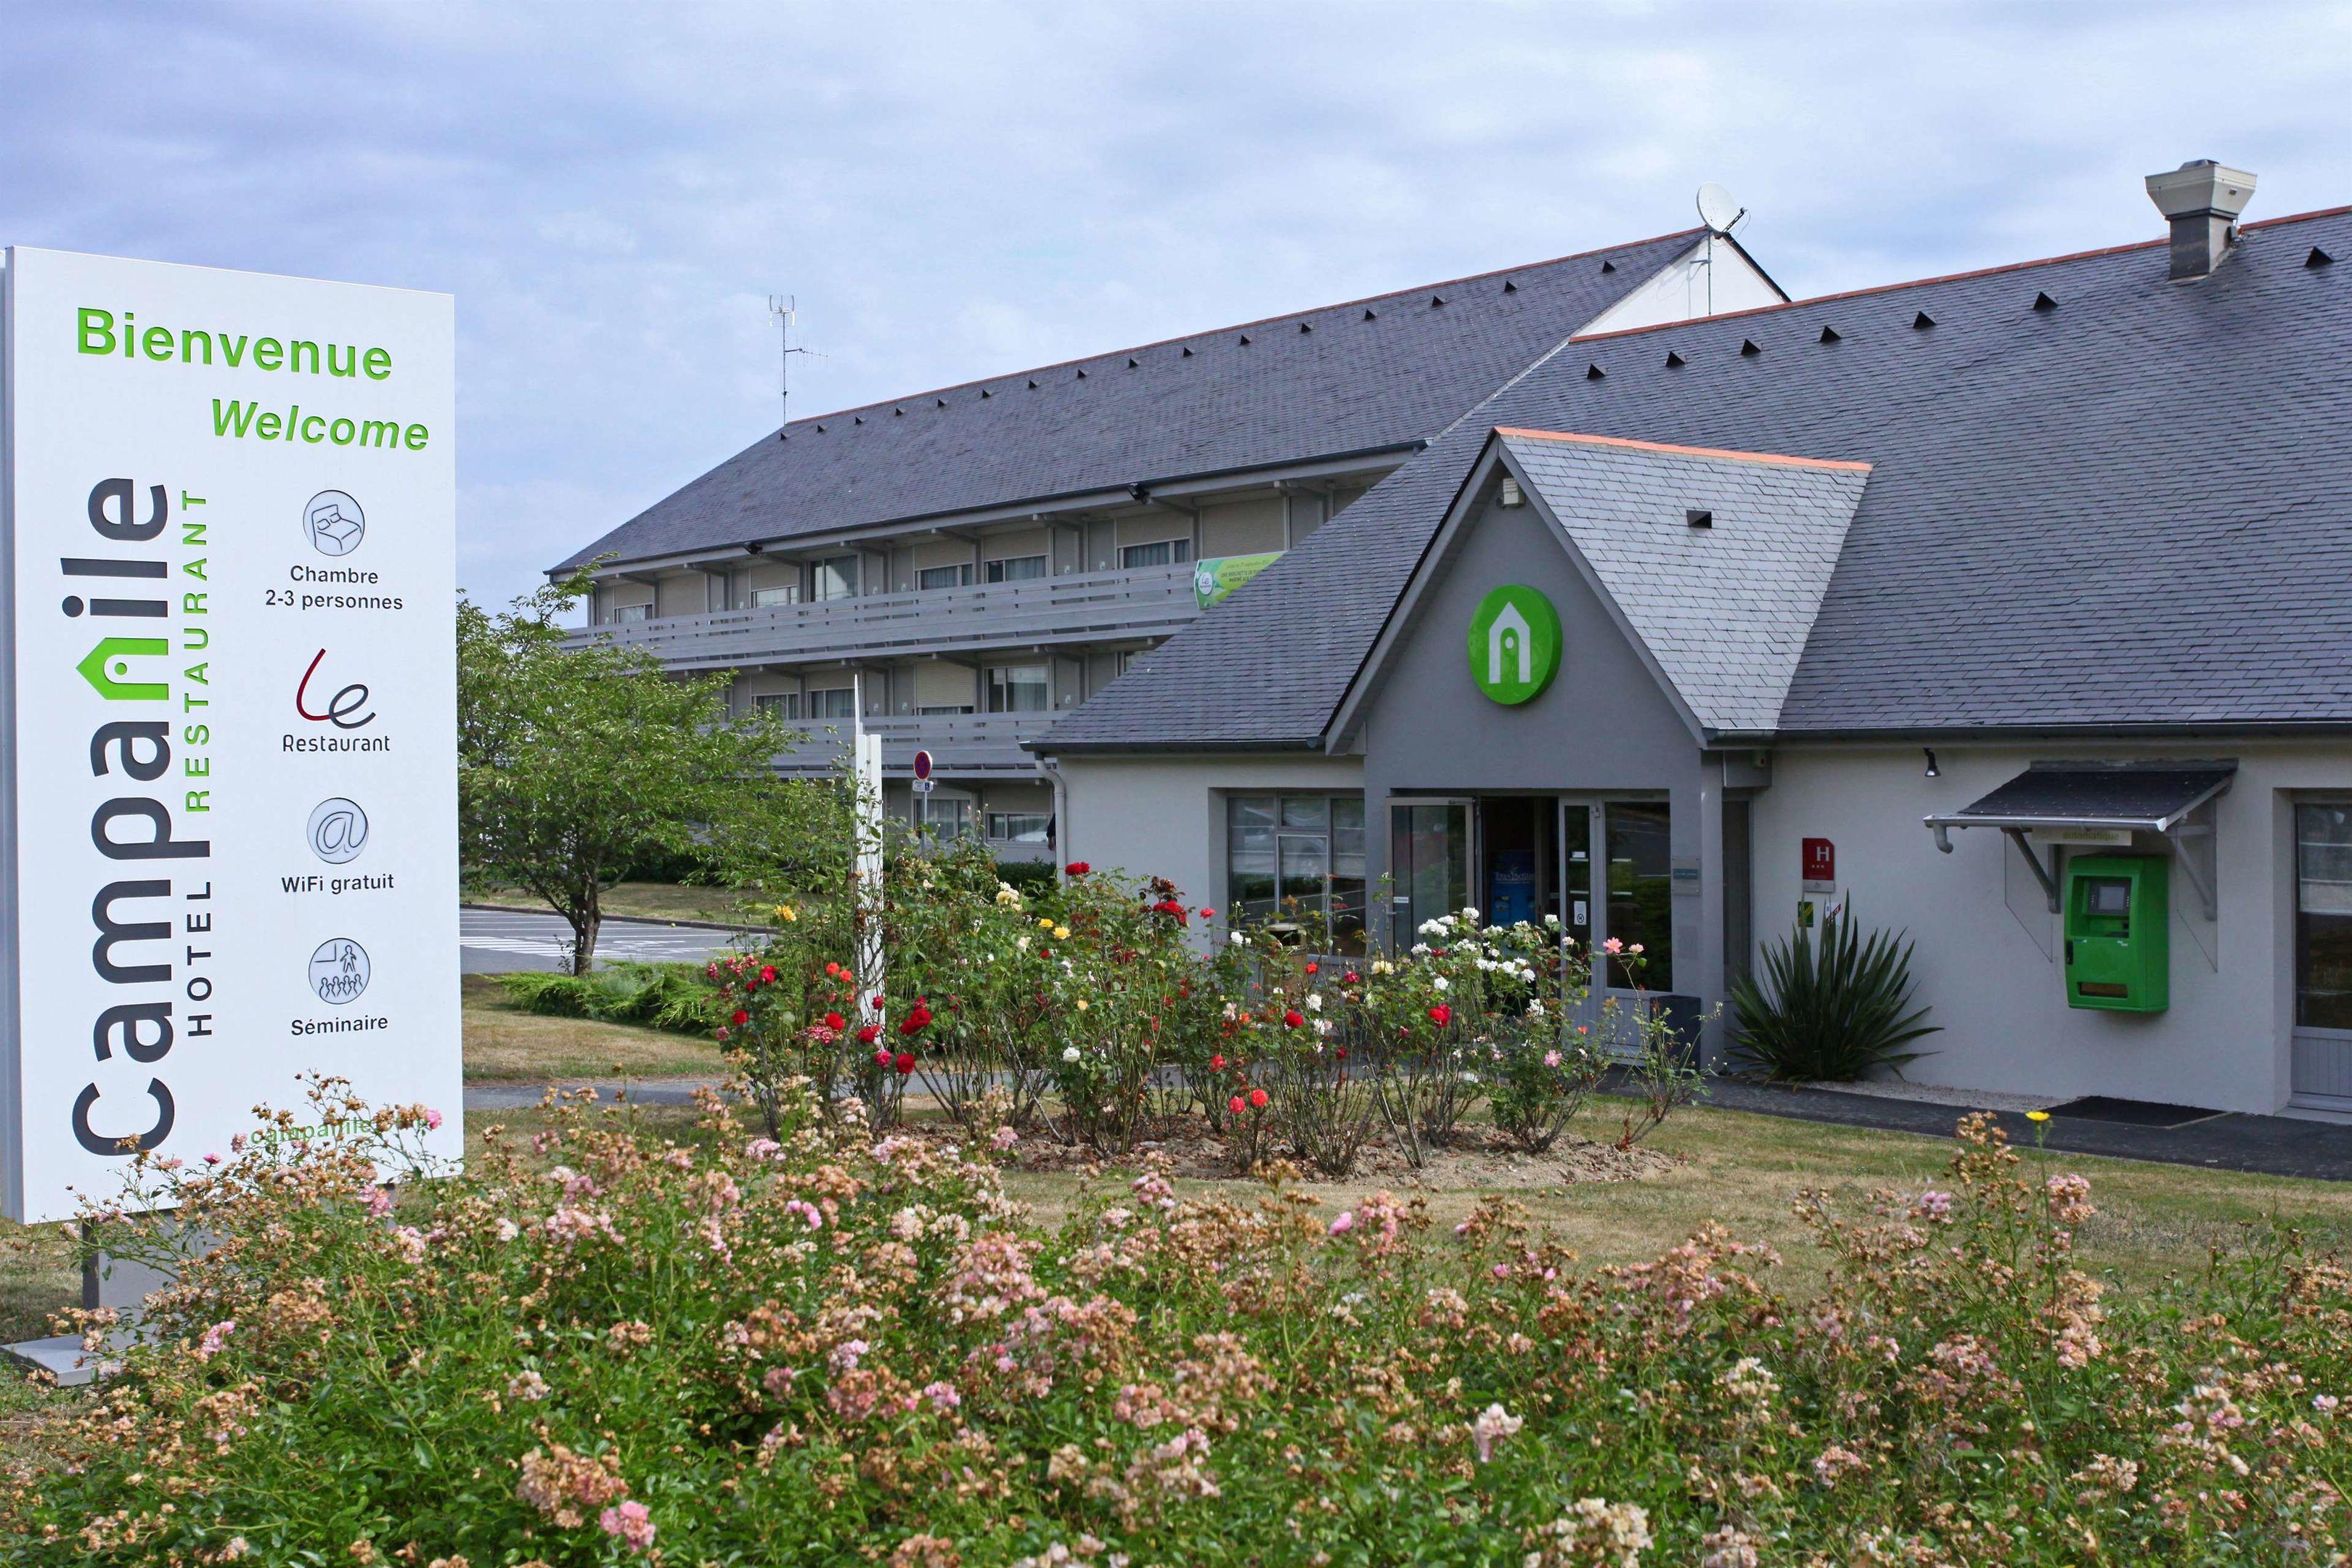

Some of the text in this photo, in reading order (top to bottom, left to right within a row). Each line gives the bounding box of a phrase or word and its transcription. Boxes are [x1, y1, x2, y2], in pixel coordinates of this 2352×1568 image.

[78, 308, 392, 380] Bienvenue
[212, 399, 429, 451] Welcome
[290, 565, 378, 584] Chambre
[266, 589, 403, 611] 2-3 personnes
[181, 491, 209, 812] RESTAURANT
[282, 734, 391, 752] Restaurant
[1816, 846, 1830, 862] H
[281, 873, 394, 895] WiFi gratuit
[186, 881, 213, 1037] HOTEL
[291, 1015, 388, 1036] Séminaire
